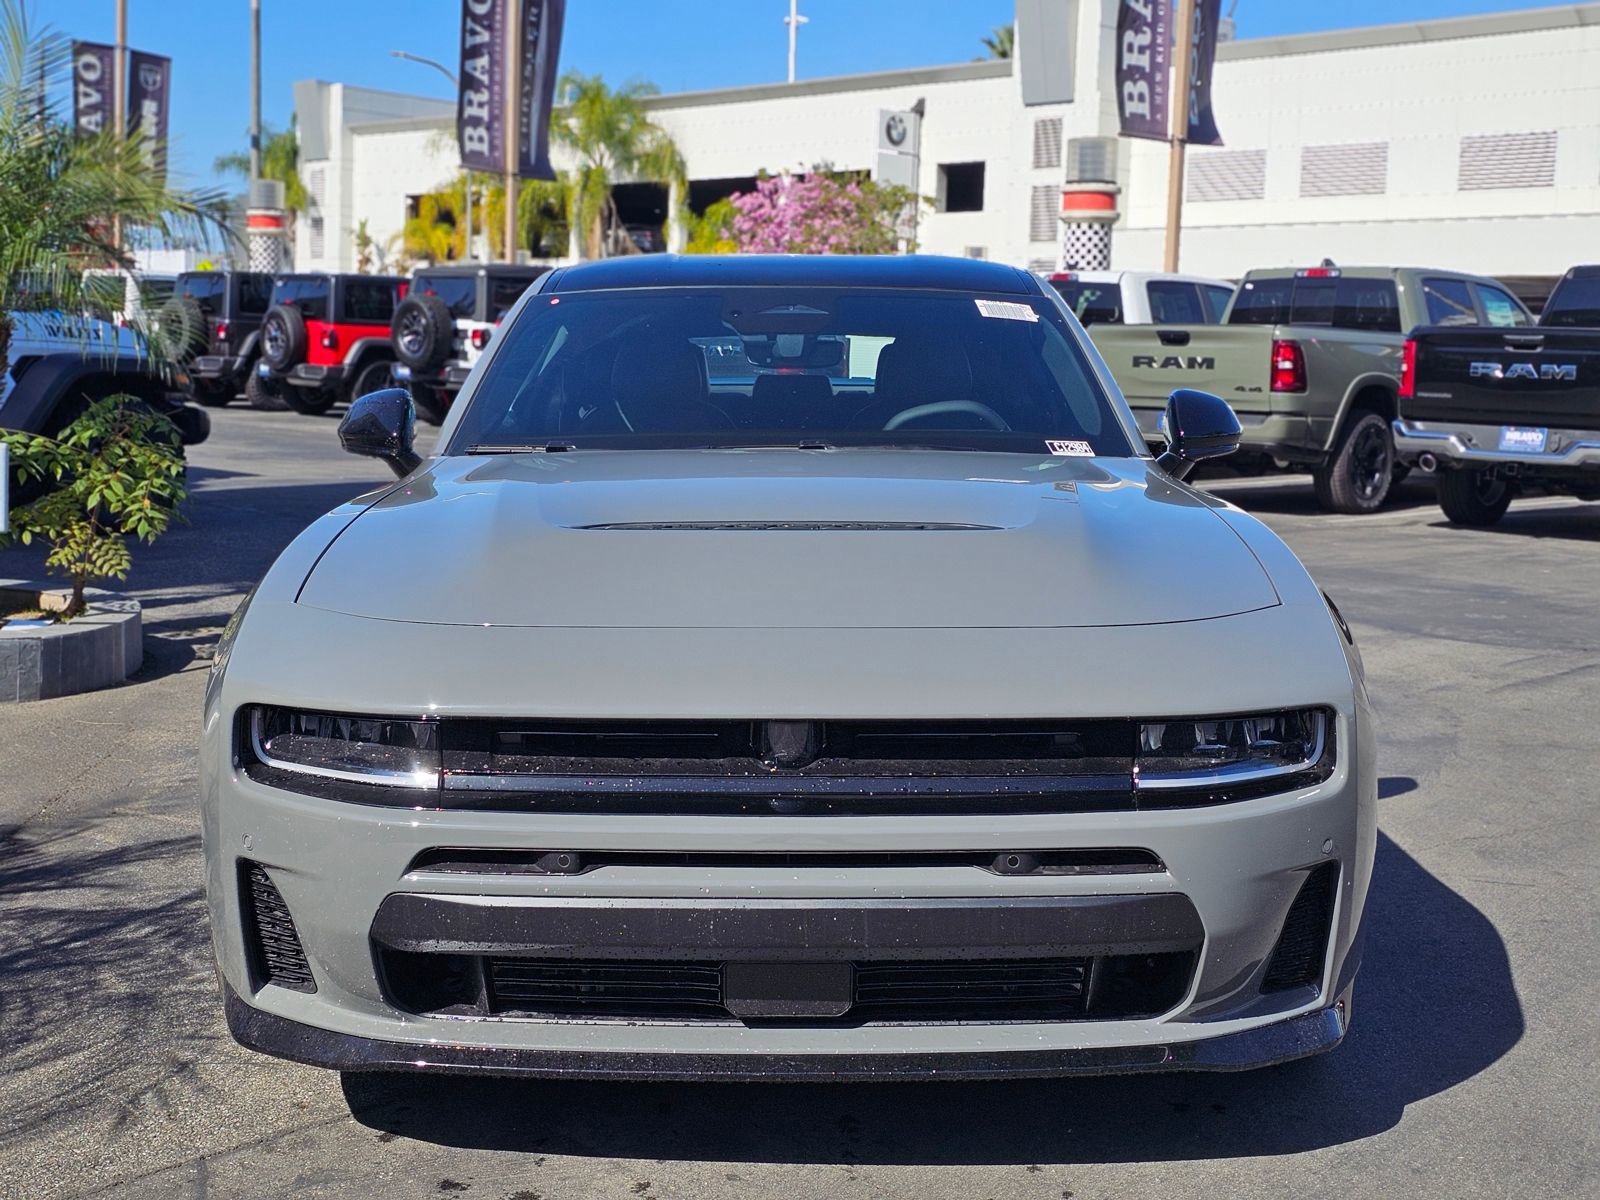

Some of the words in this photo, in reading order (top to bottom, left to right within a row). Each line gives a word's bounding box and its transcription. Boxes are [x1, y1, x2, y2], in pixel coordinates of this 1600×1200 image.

[1155, 23, 1165, 64] KIND
[1132, 355, 1216, 370] RAM
[1470, 362, 1577, 380] RAM
